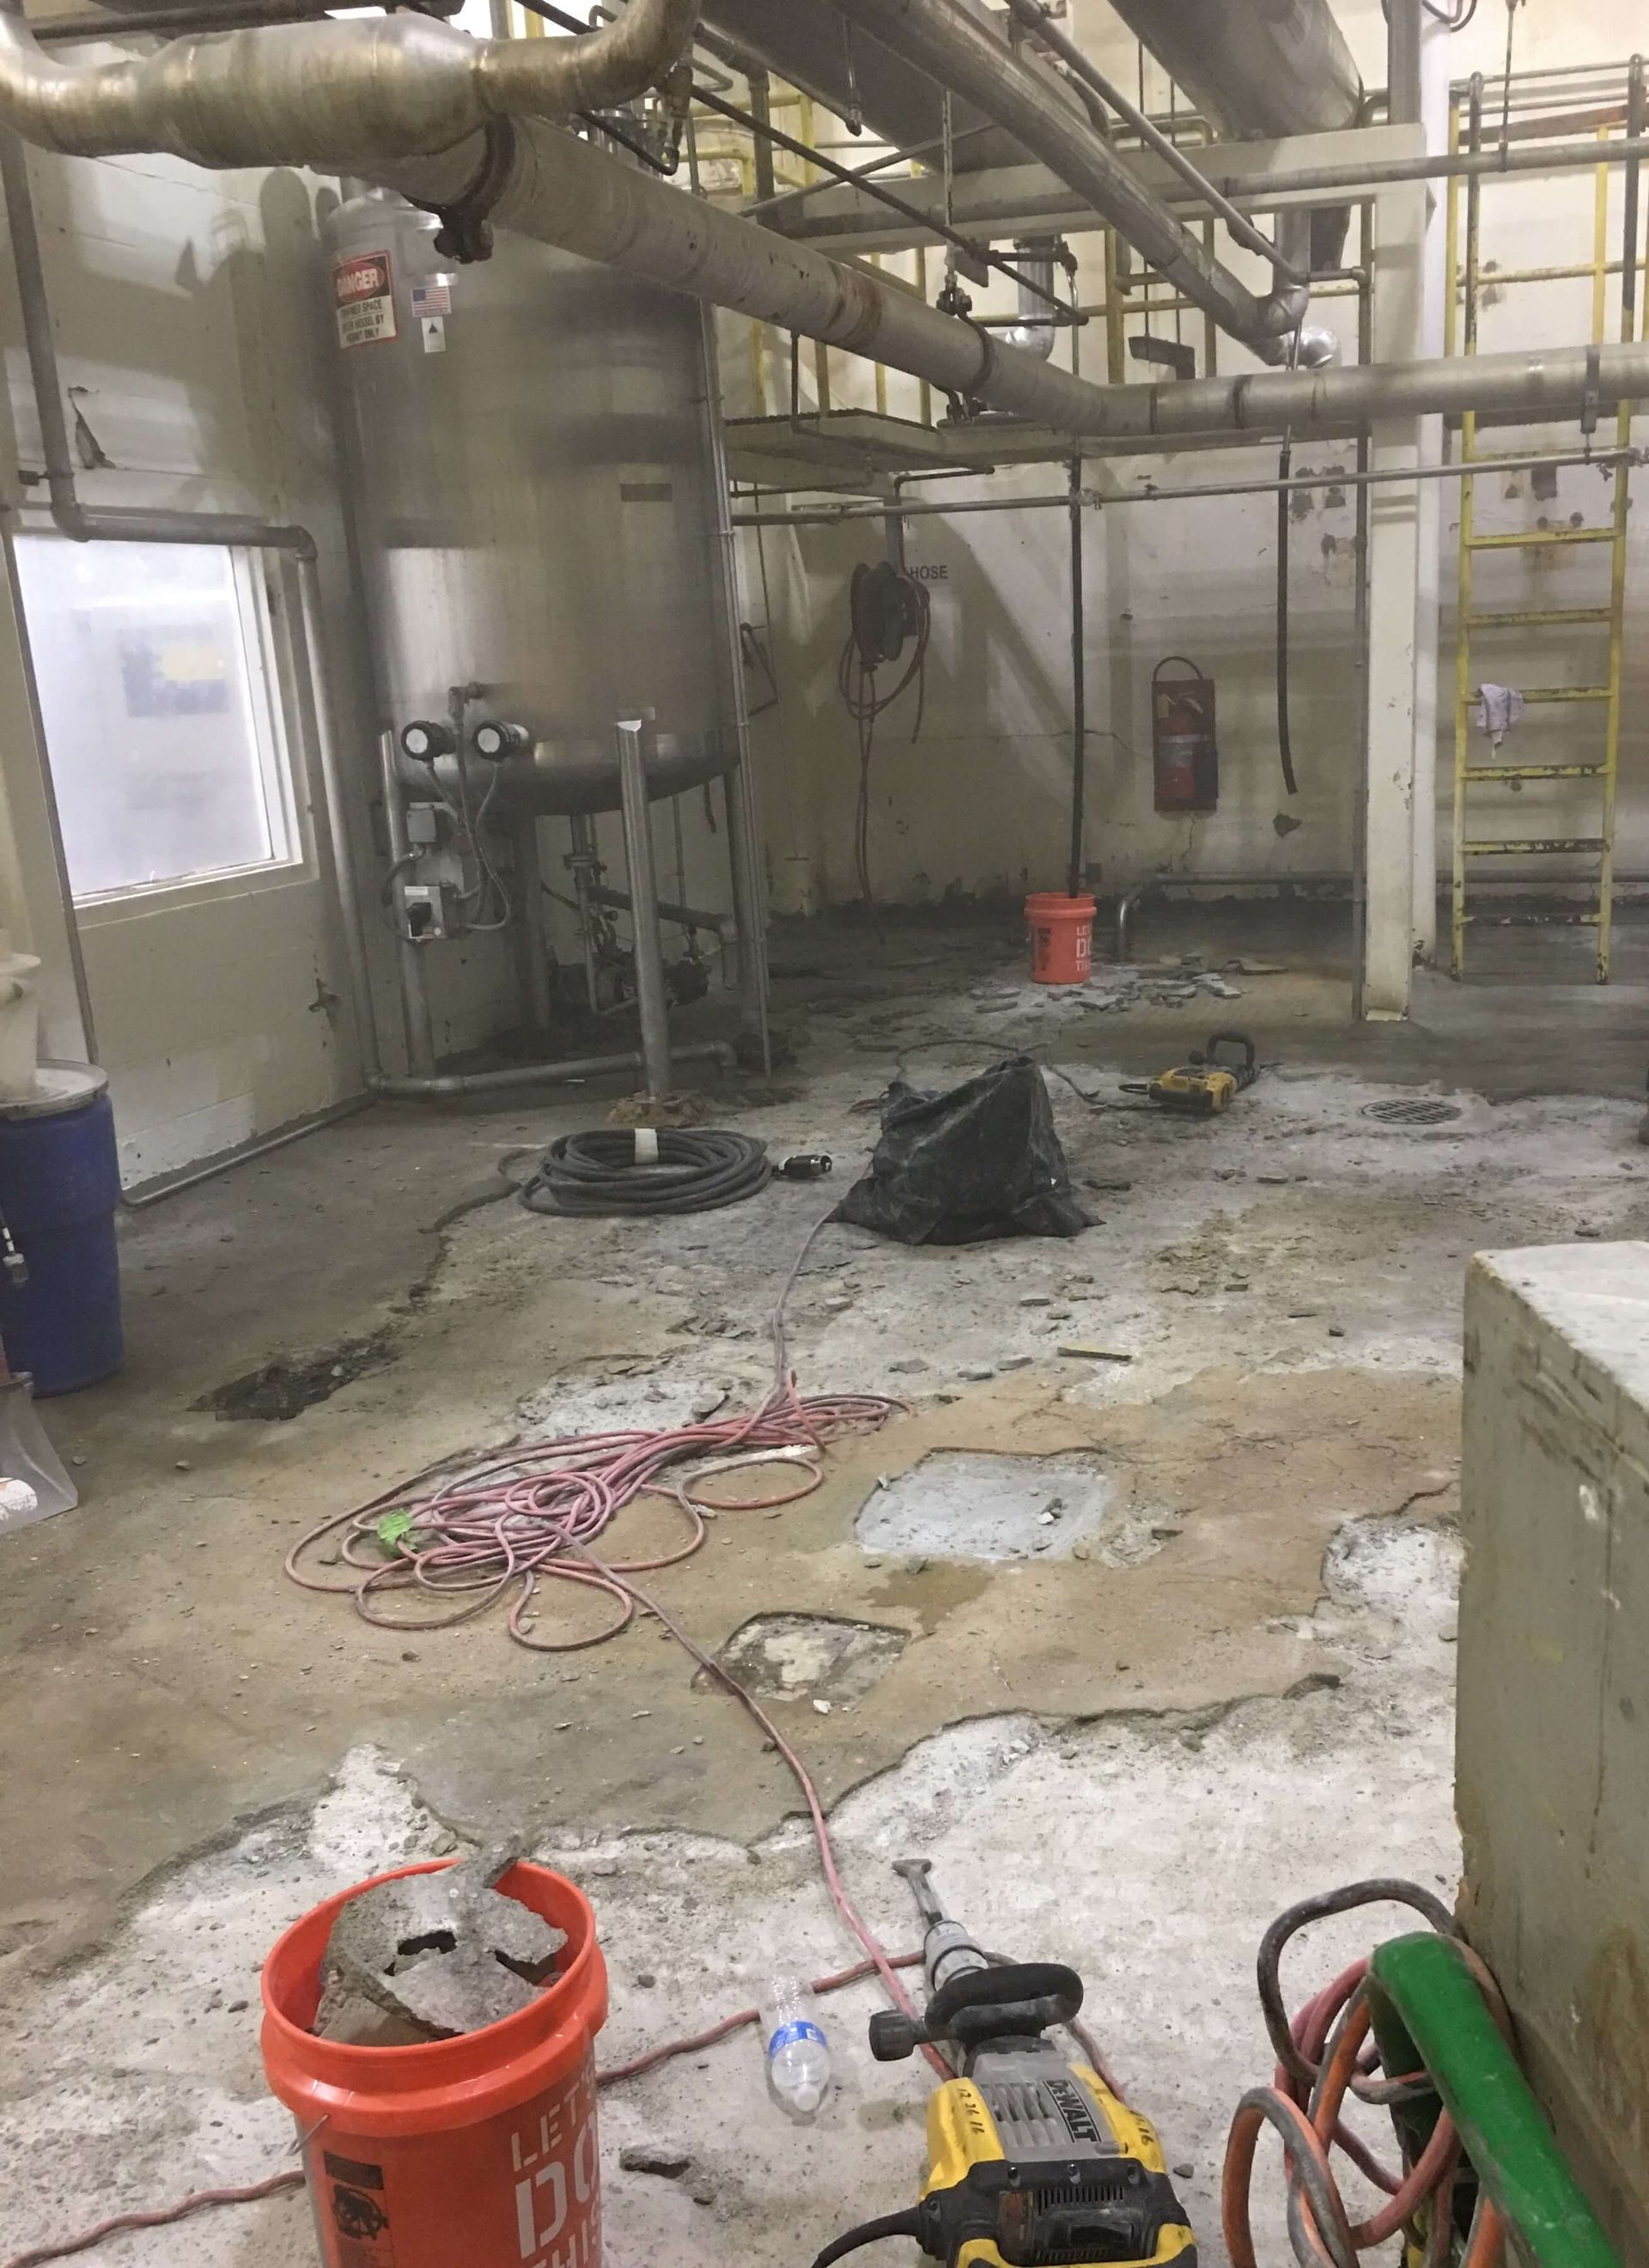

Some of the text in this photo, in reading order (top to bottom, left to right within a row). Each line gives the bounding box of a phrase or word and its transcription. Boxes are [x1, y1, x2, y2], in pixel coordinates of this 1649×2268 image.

[337, 268, 379, 297] DANGER
[362, 299, 383, 313] SPACE
[375, 313, 384, 324] BY
[910, 565, 948, 580] HOSE
[970, 2121, 985, 2135] 16
[1138, 2127, 1154, 2146] 16
[515, 2109, 599, 2260] DO
[531, 2192, 600, 2268] HI
